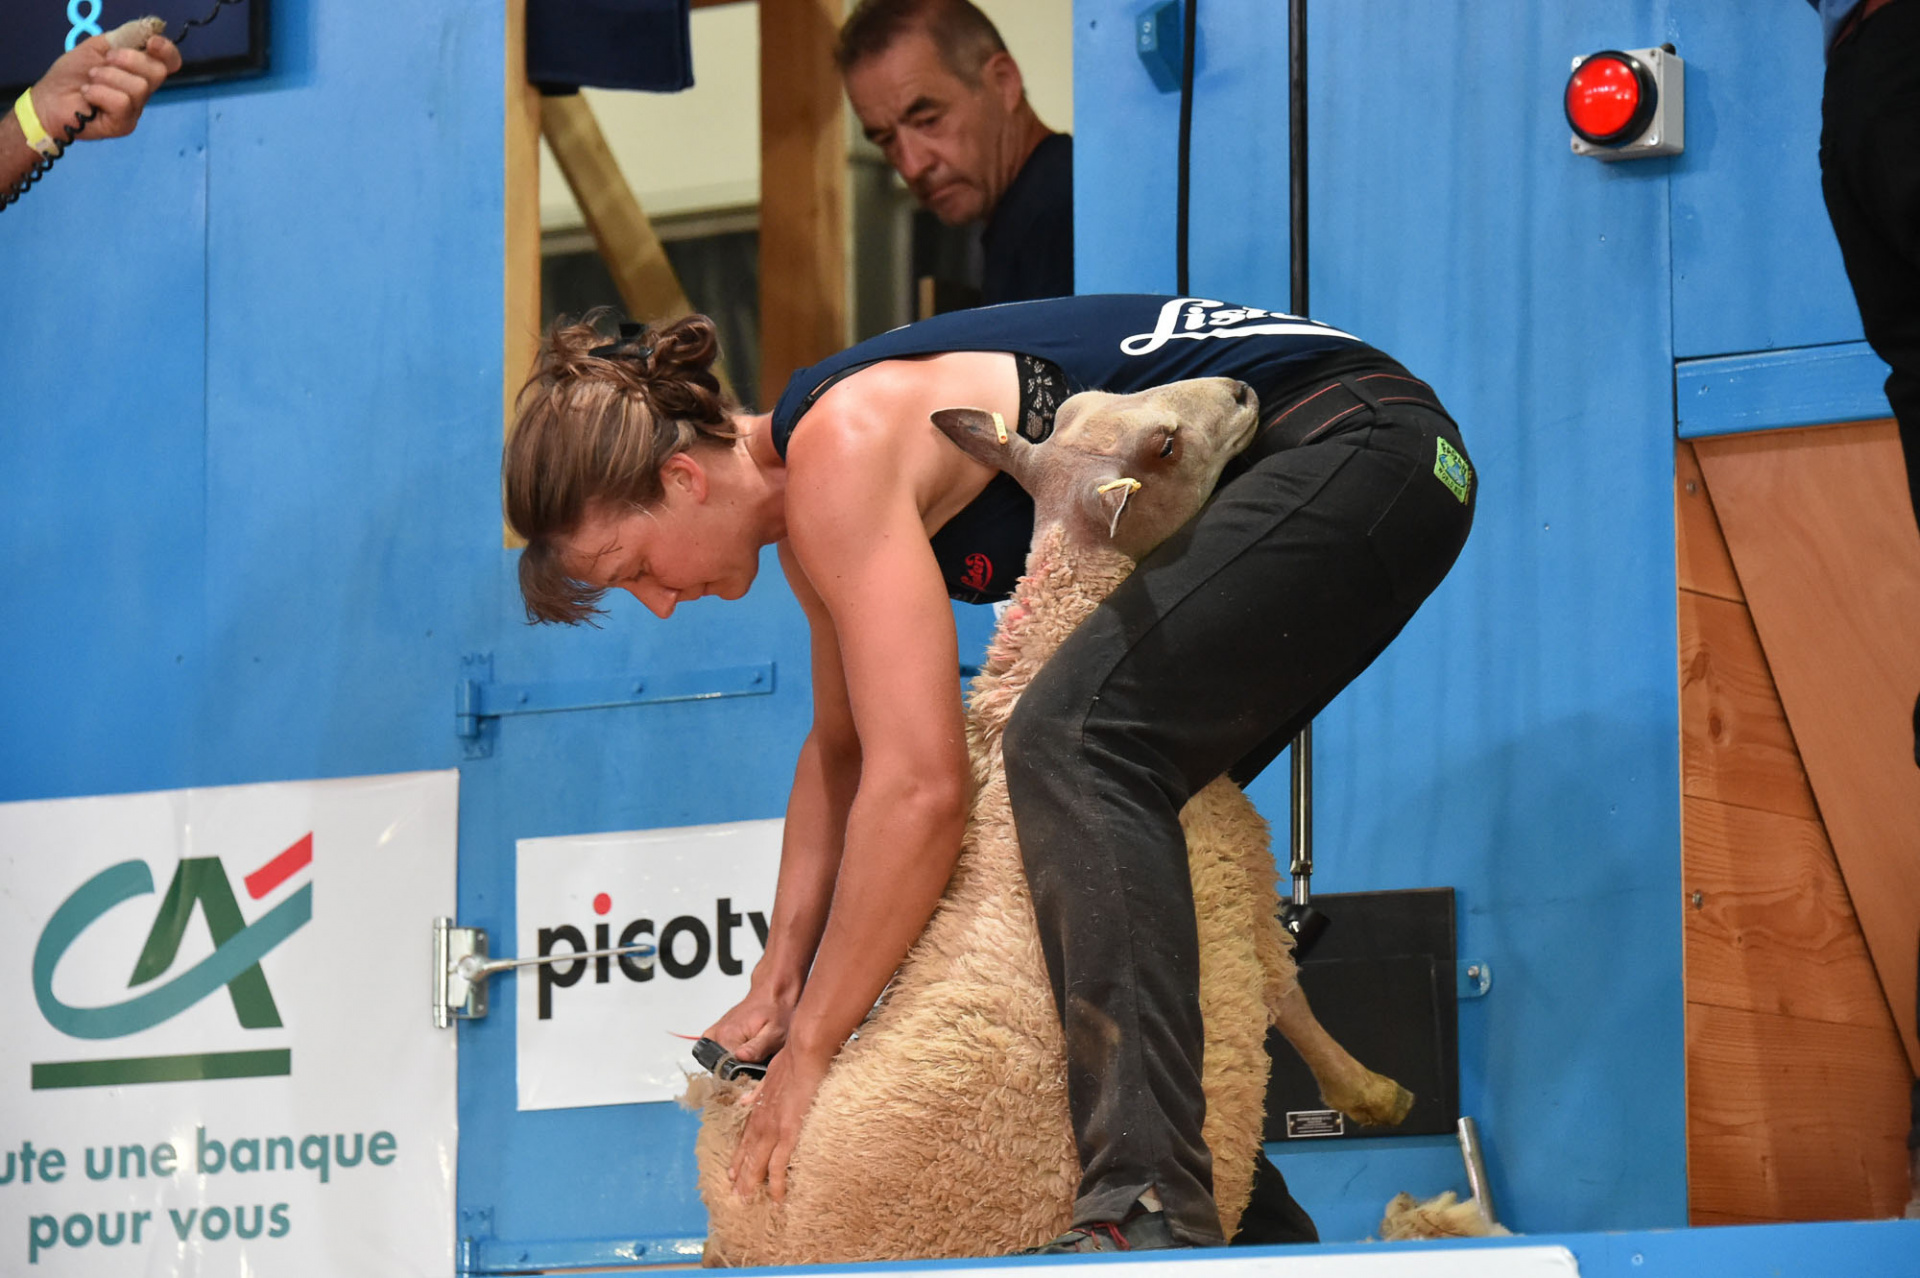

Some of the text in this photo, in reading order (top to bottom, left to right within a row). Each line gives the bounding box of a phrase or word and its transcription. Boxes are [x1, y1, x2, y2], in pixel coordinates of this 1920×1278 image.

[1119, 297, 1363, 356] List
[85, 1142, 178, 1181] une
[196, 1129, 398, 1183] banque
[29, 1203, 291, 1264] pour vous
